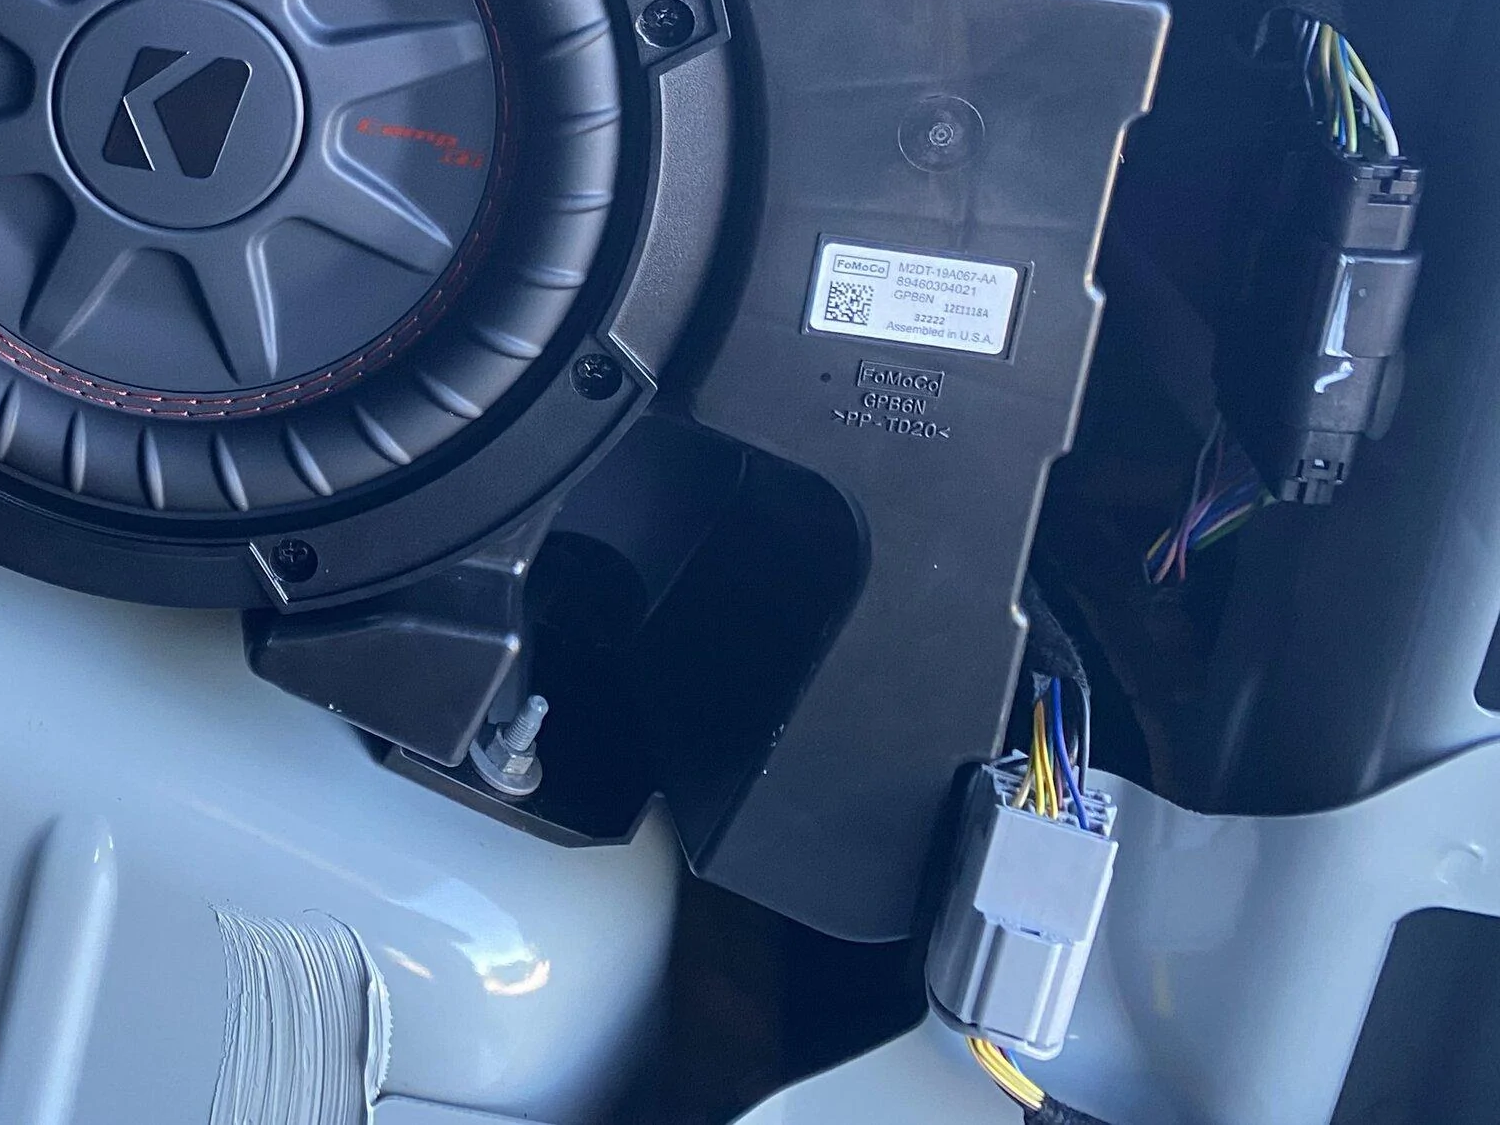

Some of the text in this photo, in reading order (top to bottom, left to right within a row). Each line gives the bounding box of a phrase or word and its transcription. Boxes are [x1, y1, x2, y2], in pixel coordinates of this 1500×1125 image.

[836, 259, 885, 274] FoMoCo
[896, 276, 976, 296] 89460304021
[893, 290, 935, 304] GPB6N
[886, 321, 994, 344] Assembled in U.S.A.
[860, 368, 939, 392] FoMoCo
[863, 393, 926, 415] GPB6N
